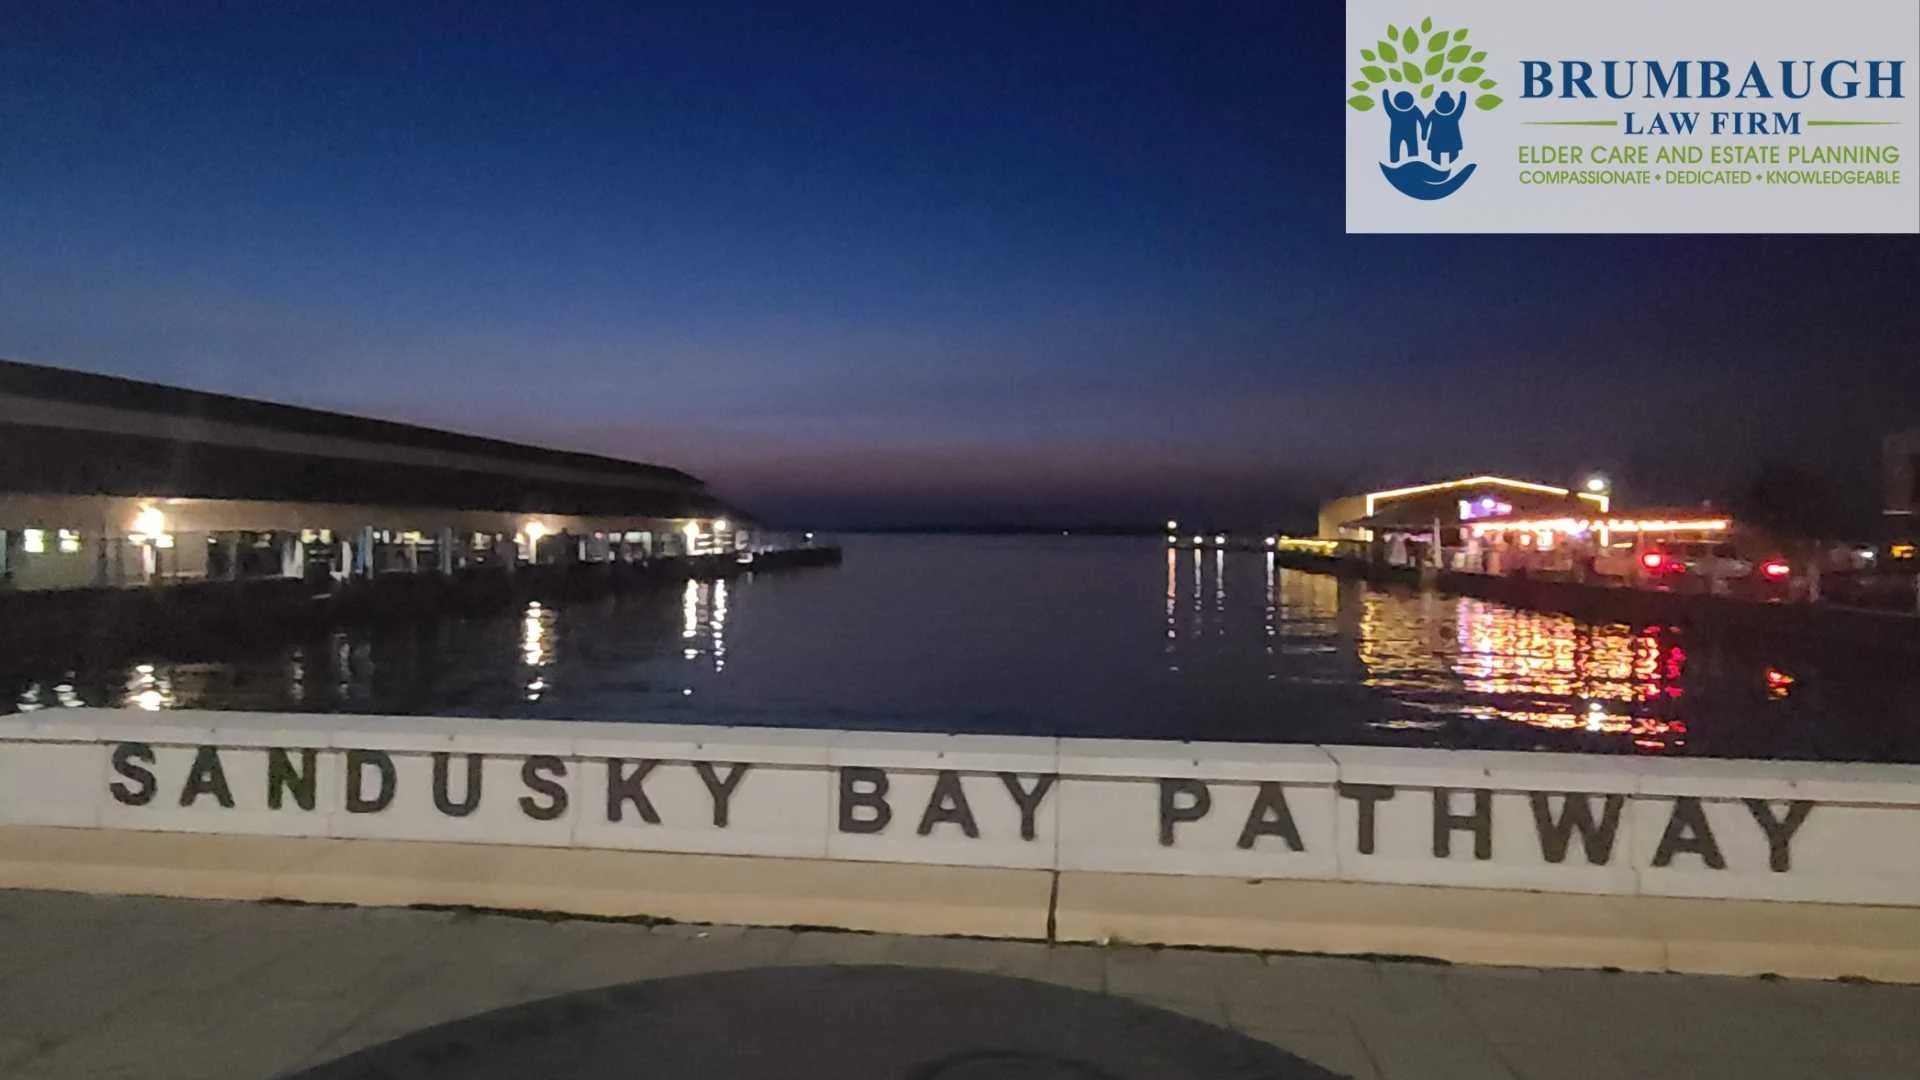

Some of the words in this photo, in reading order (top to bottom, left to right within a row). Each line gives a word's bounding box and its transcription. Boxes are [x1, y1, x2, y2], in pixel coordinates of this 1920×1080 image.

[109, 742, 749, 827] SANDUSKY
[839, 766, 1058, 840] BAY
[1160, 778, 1813, 873] PATHWAY
